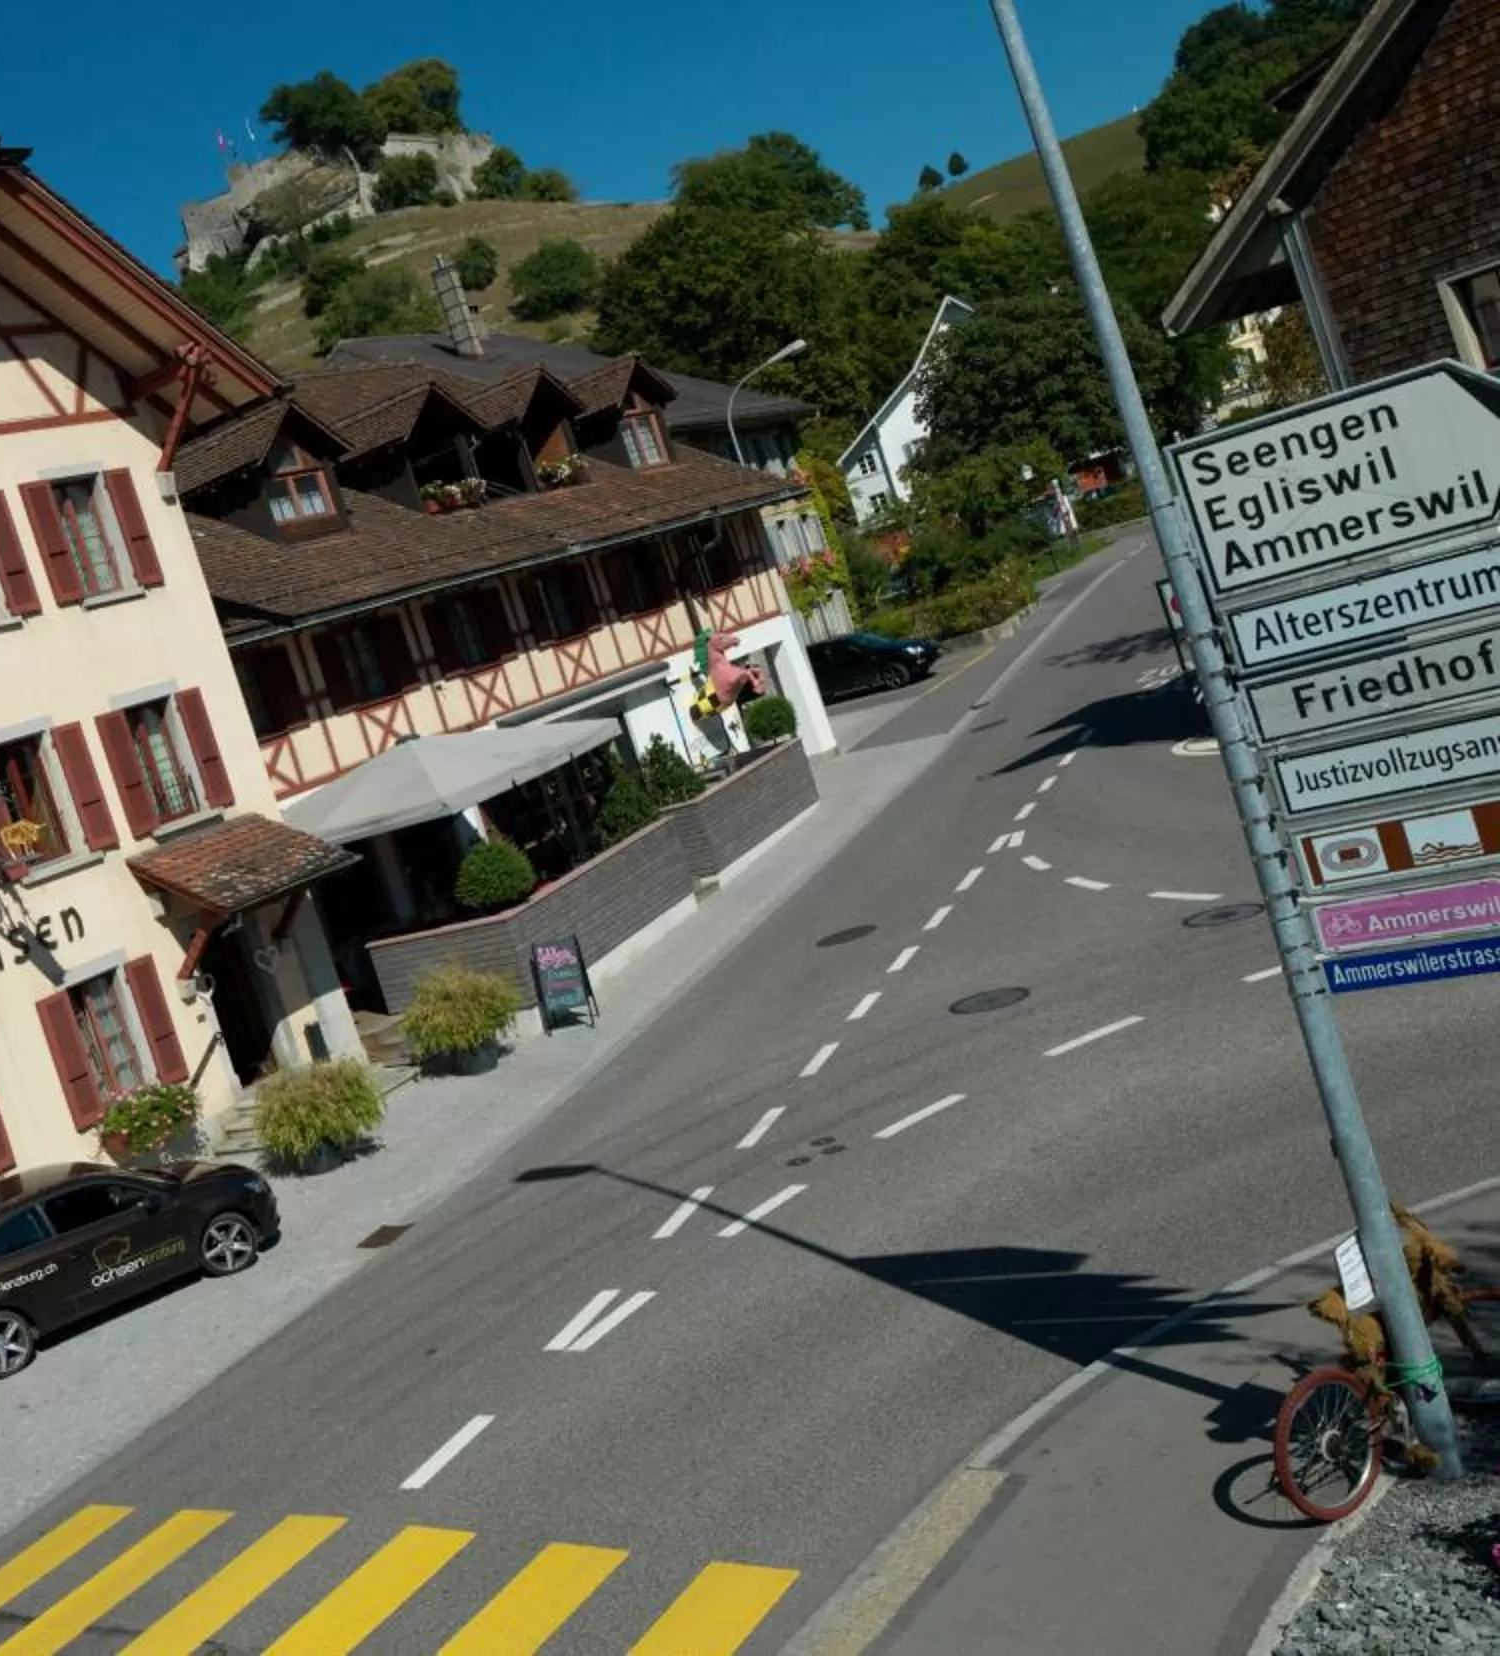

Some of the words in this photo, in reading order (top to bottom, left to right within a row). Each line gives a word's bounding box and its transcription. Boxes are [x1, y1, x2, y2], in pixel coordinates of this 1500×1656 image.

[1192, 403, 1398, 485] Seengen
[1204, 446, 1396, 531] Egliswil
[1225, 469, 1489, 576] Ammerswil
[1255, 565, 1500, 650] Alterszentrum
[1292, 638, 1495, 718] Friedhof
[1295, 735, 1500, 794] Justizvollzugsan
[1368, 896, 1500, 932] Ammerswil
